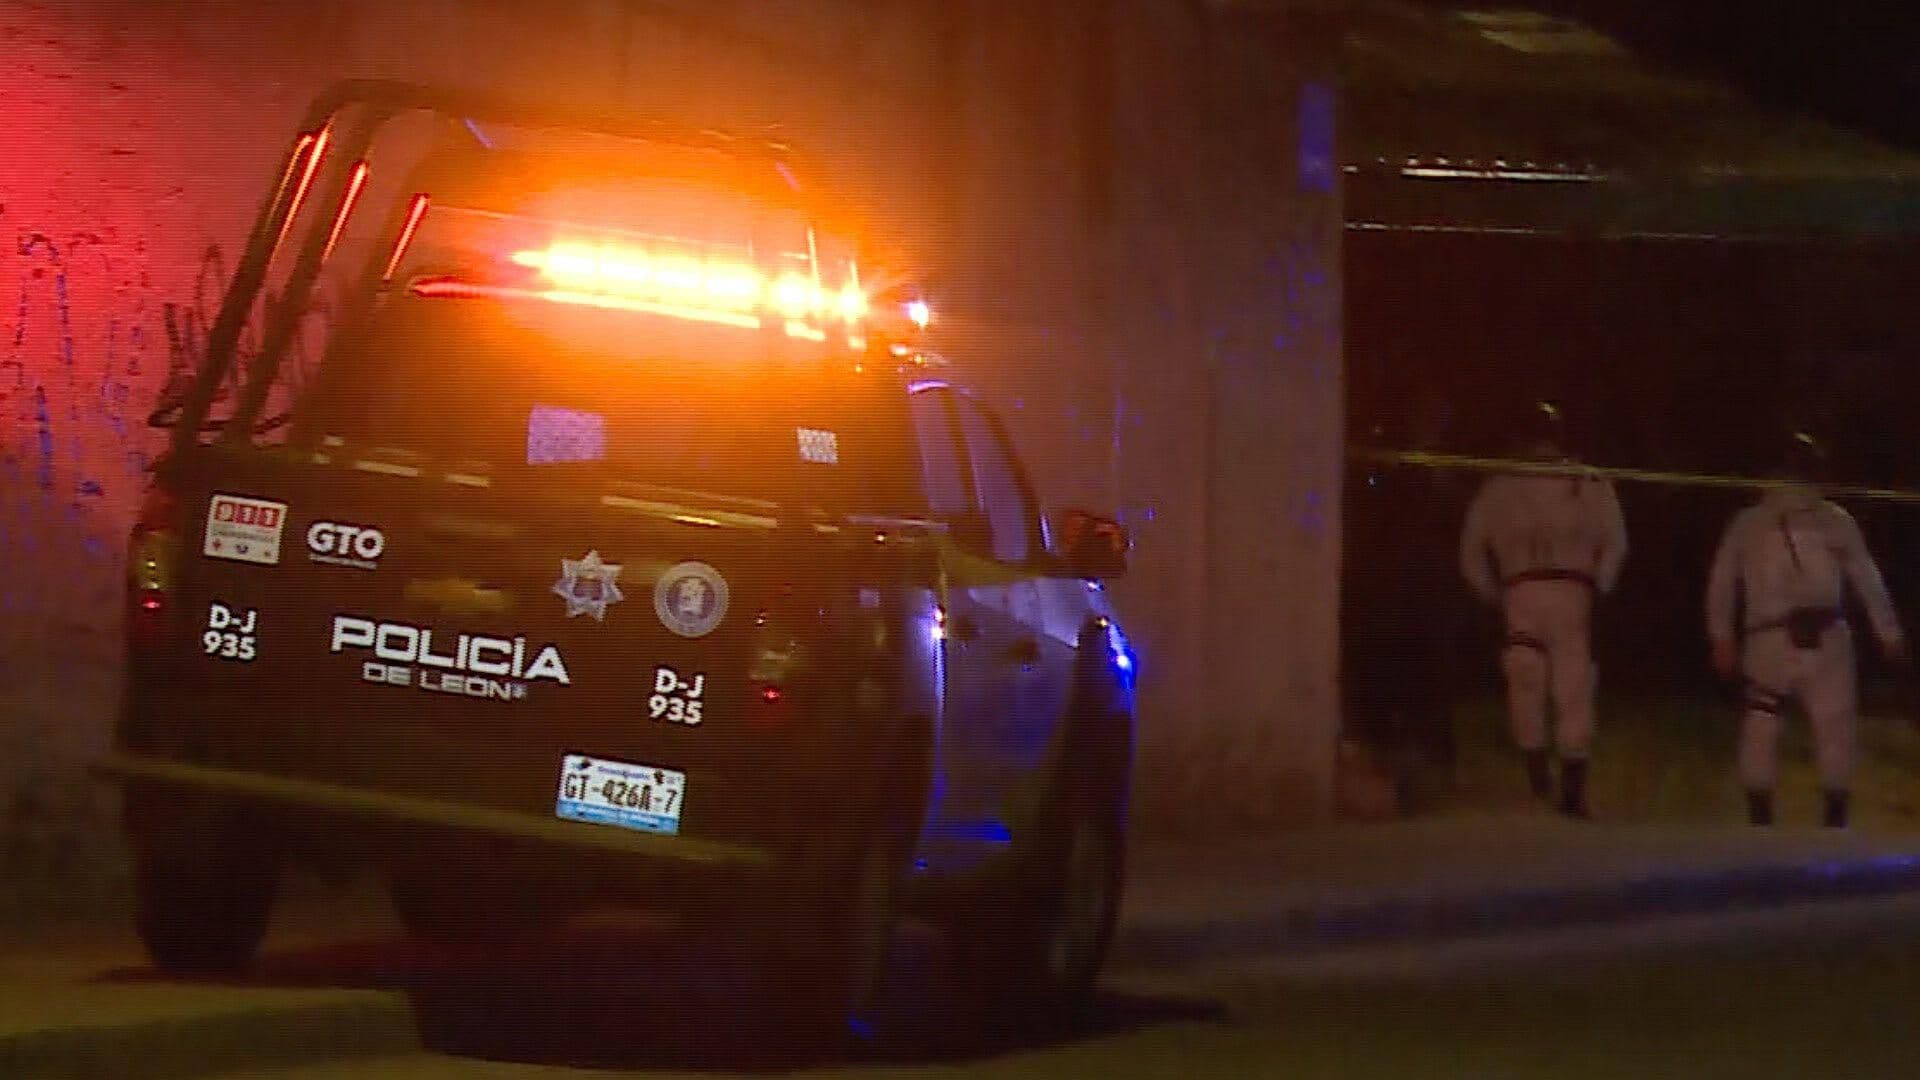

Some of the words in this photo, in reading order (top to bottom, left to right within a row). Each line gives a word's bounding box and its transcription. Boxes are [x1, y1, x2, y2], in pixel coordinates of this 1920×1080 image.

[307, 522, 384, 559] GTO
[210, 604, 257, 634] D-J
[203, 631, 256, 660] 935
[331, 615, 570, 685] POLICÍA
[363, 662, 412, 686] DE
[654, 668, 704, 698] D-J
[649, 695, 702, 725] 935
